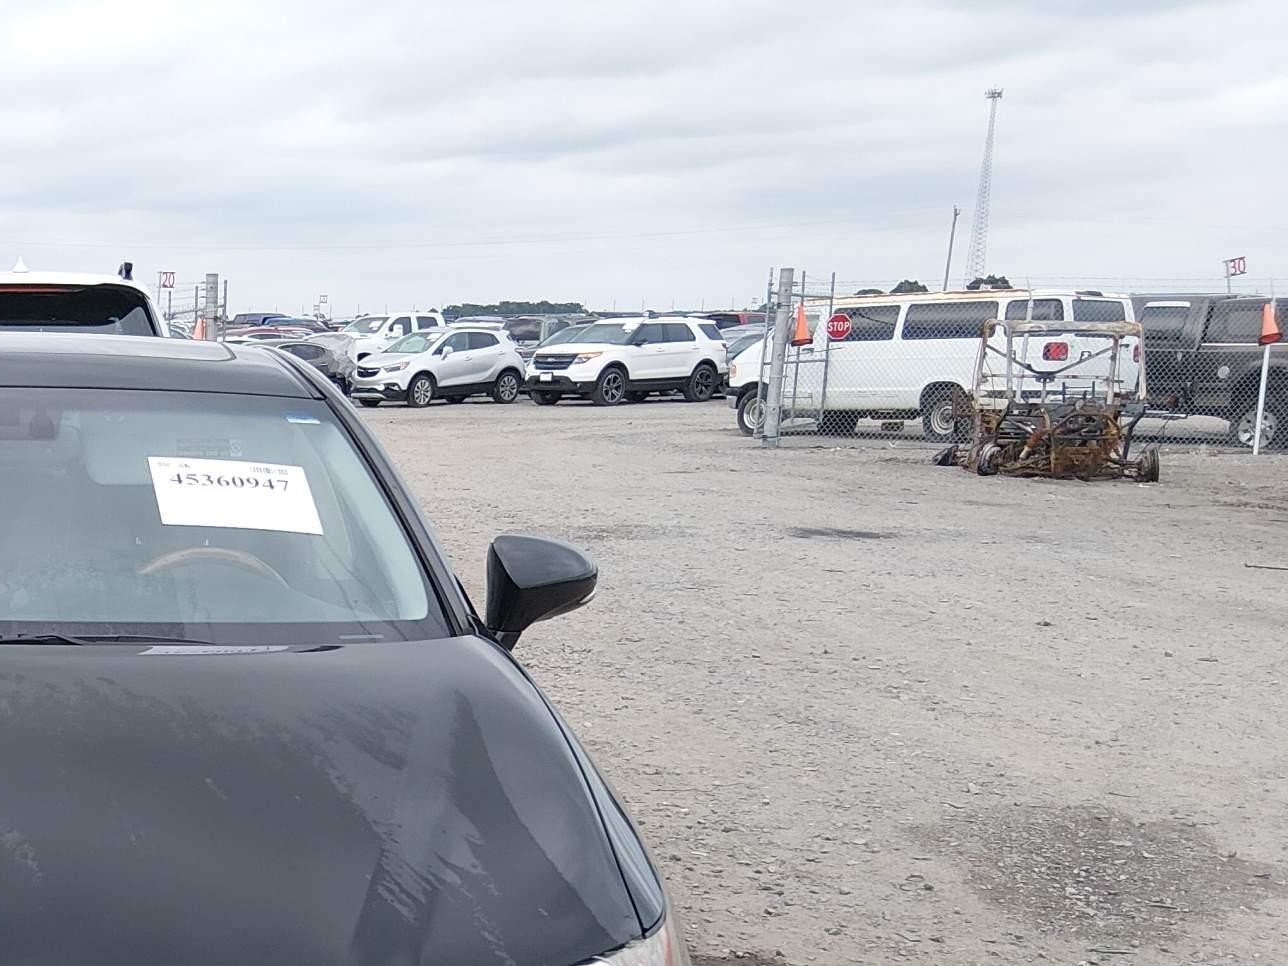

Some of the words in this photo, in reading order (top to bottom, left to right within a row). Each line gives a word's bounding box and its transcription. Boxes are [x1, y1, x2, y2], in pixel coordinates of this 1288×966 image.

[1230, 257, 1246, 274] 30
[162, 271, 175, 288] 20
[827, 321, 850, 332] STOP
[169, 473, 289, 492] 45360947
